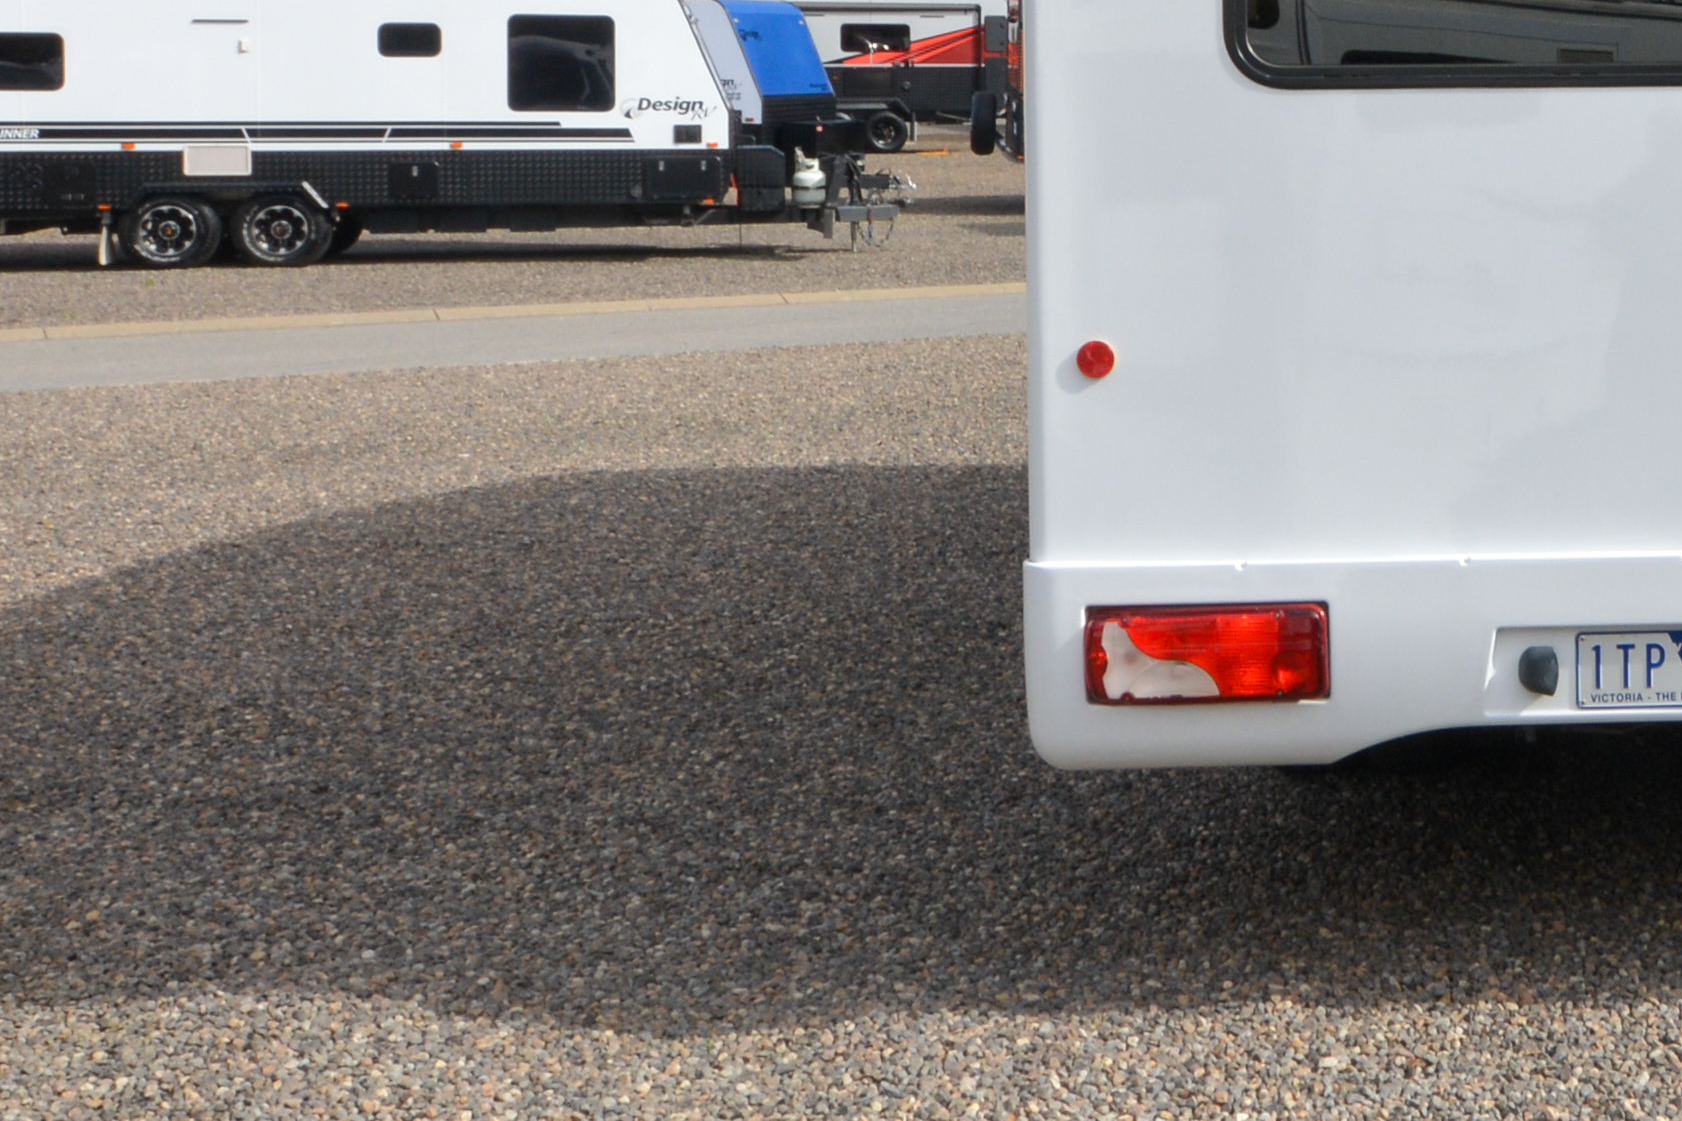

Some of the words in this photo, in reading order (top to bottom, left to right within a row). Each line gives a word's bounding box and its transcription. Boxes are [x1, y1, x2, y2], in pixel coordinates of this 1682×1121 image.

[637, 96, 704, 115] Design
[1591, 642, 1666, 689] 1TP
[1590, 693, 1644, 703] VICTORIA
[1655, 692, 1677, 702] THE
